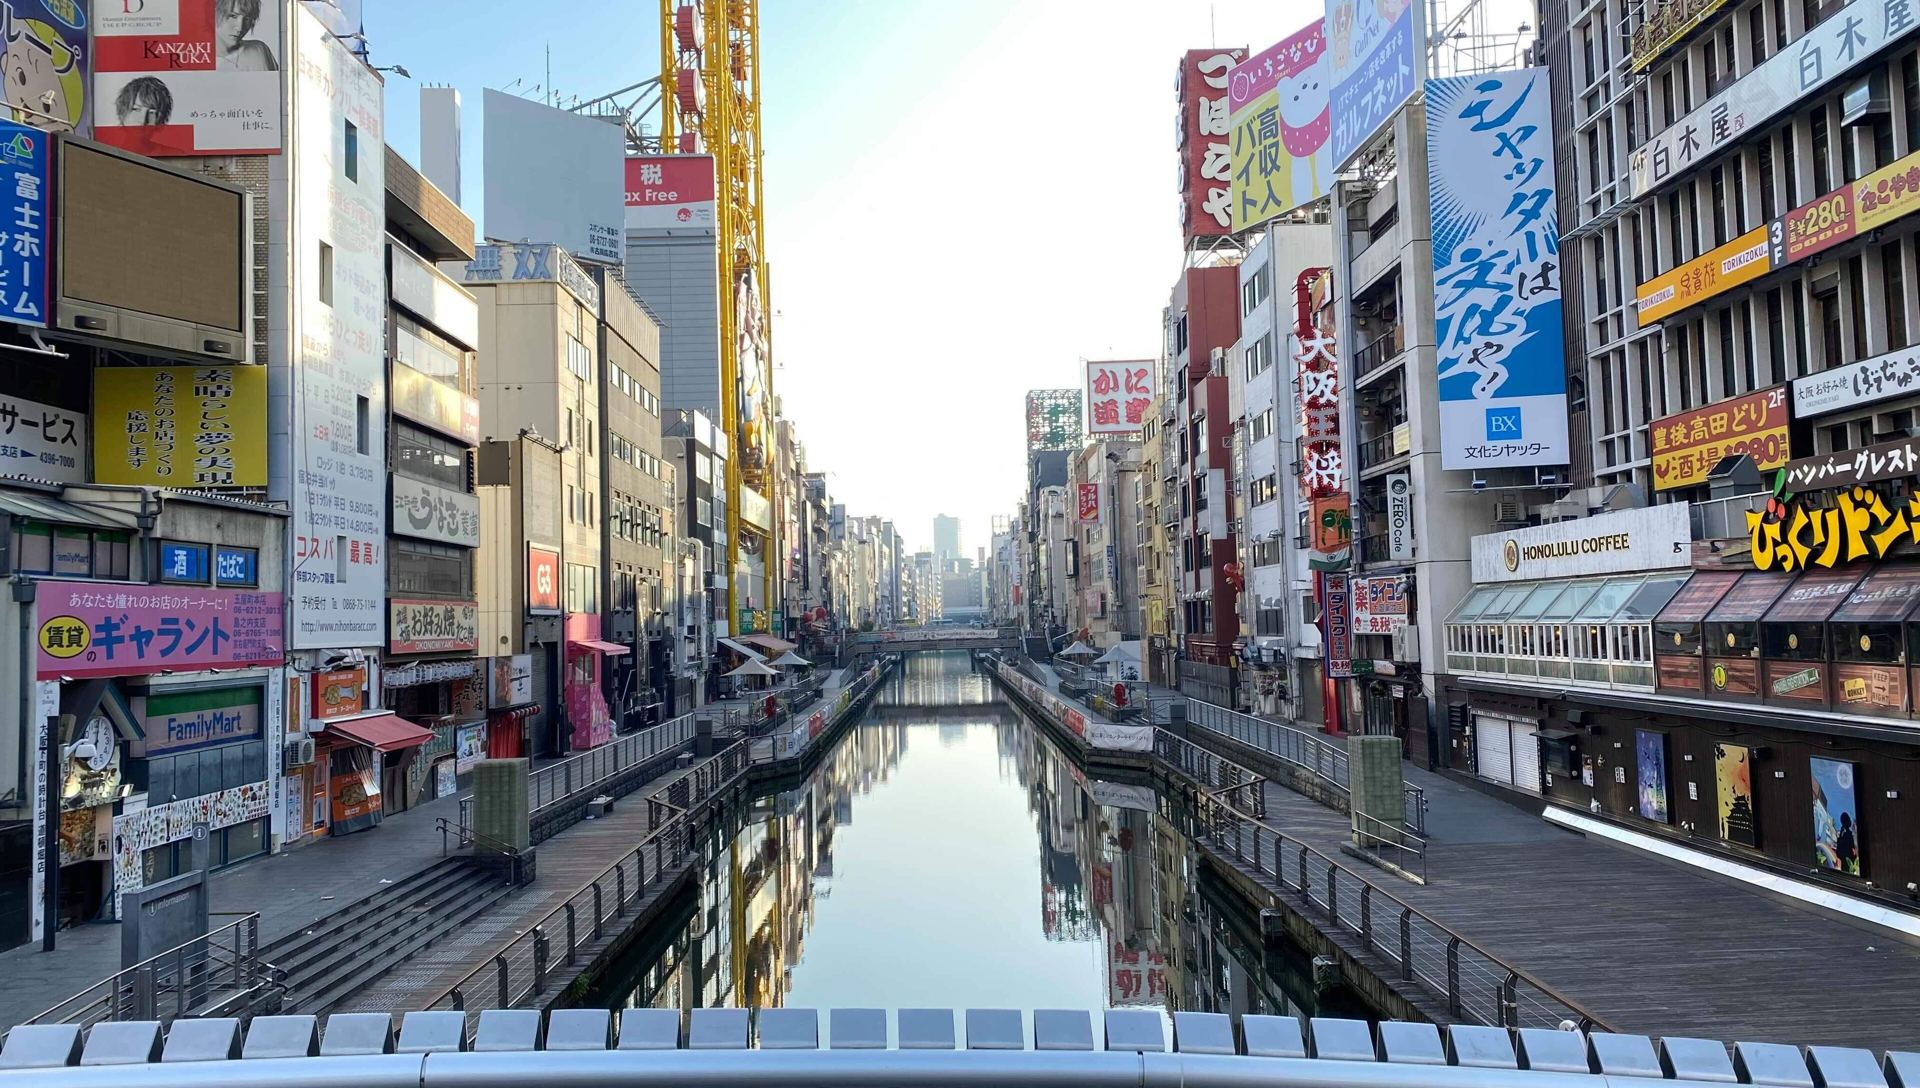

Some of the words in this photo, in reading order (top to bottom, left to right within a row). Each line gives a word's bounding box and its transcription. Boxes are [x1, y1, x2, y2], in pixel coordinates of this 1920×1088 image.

[143, 41, 211, 59] KANZAKI
[1250, 32, 1319, 84] いちごなび
[1800, 0, 1915, 92] 白木屋
[169, 53, 211, 69] RUKA
[190, 109, 263, 119] めっちゃ面白いを
[1337, 54, 1410, 156] ガルフネット
[1653, 102, 1732, 182] 白木屋
[1235, 116, 1257, 223] バイト
[1257, 104, 1281, 214] 高収入
[641, 164, 662, 185] 税
[625, 191, 640, 201] ax
[645, 189, 678, 201] Free
[13, 172, 40, 317] 富士ホーム
[1771, 222, 1783, 265] 3F
[1723, 245, 1764, 272] TORIKIZOKU
[1638, 288, 1671, 310] TORIKIZOKU
[1092, 368, 1150, 395] かに
[1797, 378, 1848, 401] 大阪お好み焼
[1299, 328, 1343, 490] 大阪王将
[1768, 389, 1785, 408] 2F
[1, 403, 77, 447] サービス
[154, 371, 175, 476] あなたのお店づくり
[194, 369, 234, 485] 素晴らしい夢の実現
[1491, 416, 1518, 432] BX
[1654, 398, 1767, 452] 豊後高田どり
[127, 410, 150, 468] 応援します
[39, 452, 75, 468] 4396-7000
[1788, 444, 1919, 486] ハンバーグレスト
[1087, 485, 1097, 507] ツルハ
[1392, 497, 1405, 529] ZERO
[297, 536, 334, 560] コスパ
[350, 540, 379, 565] 最高!
[1393, 529, 1402, 553] cafe
[1523, 540, 1579, 561] HONOLULU
[1581, 532, 1630, 555] COFFEE
[174, 549, 187, 576] 酒
[217, 554, 245, 579] たばこ
[70, 592, 228, 610] あなたも憧れのお店のオーナーに!
[1354, 580, 1369, 614] 薬
[412, 605, 455, 637] お好み焼
[46, 626, 84, 648] 賃貸
[86, 650, 97, 662] の
[92, 614, 230, 660] ギャラント
[1873, 671, 1889, 683] KEEP
[167, 711, 242, 742] FamilyMart
